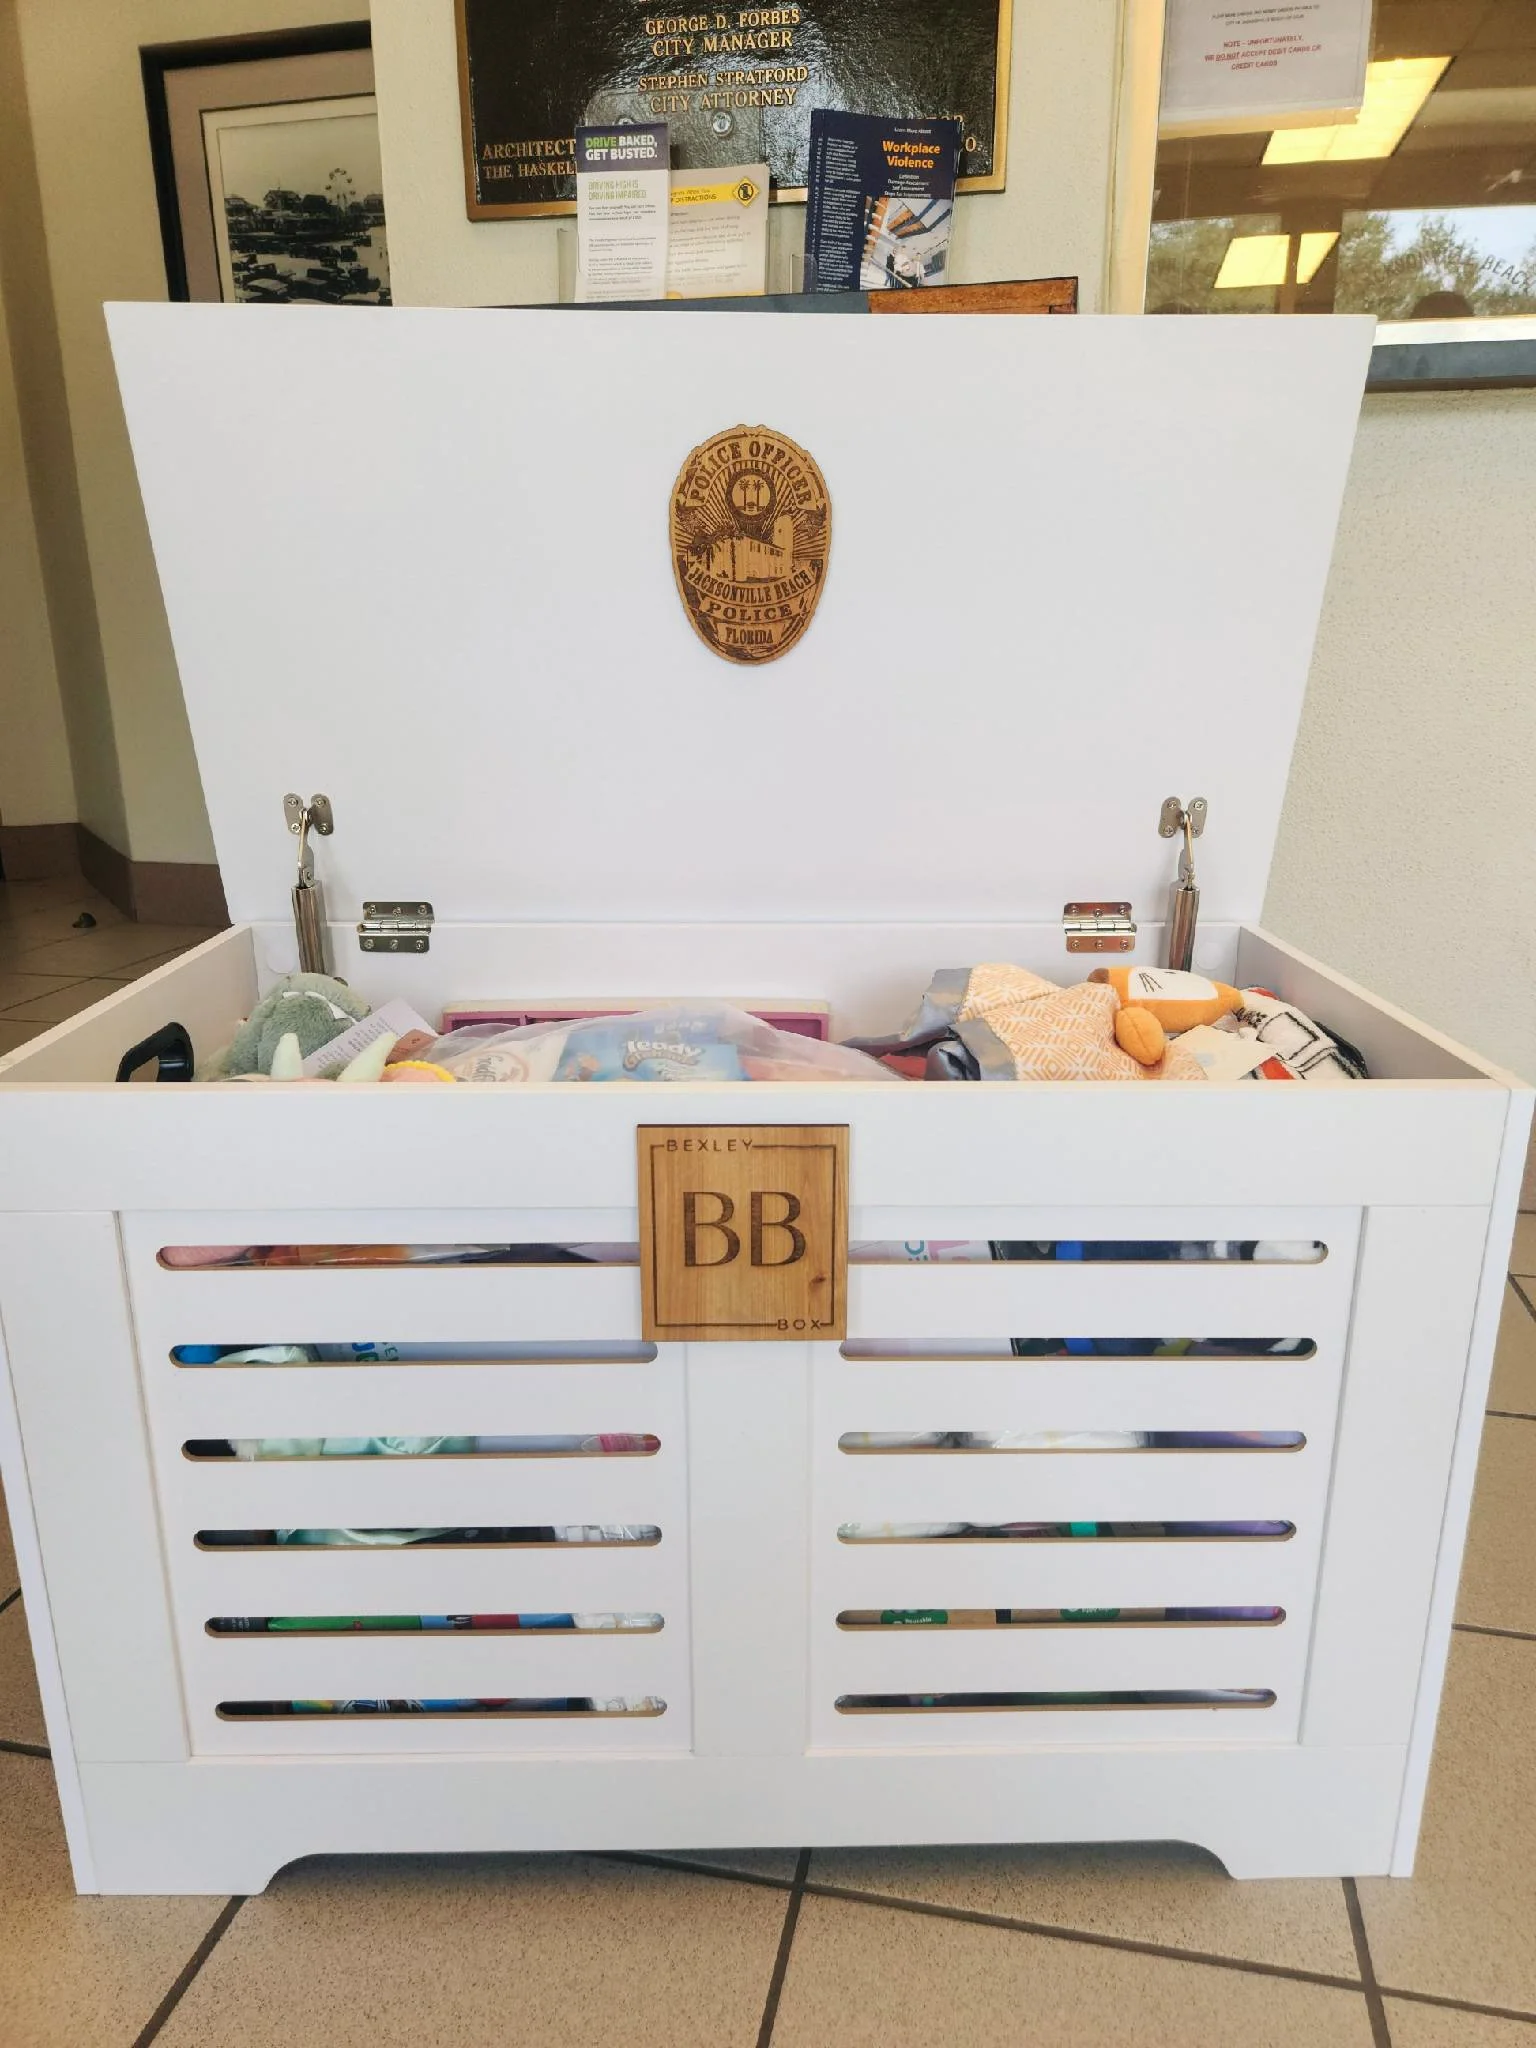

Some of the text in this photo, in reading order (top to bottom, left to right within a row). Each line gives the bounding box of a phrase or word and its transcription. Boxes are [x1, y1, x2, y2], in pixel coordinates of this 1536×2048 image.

[645, 9, 801, 35] GEORGE D. FORBES
[652, 30, 793, 57] CITY MANAGER
[1227, 52, 1240, 60] NOT
[638, 66, 809, 93] STEPHEN STRATFORD
[650, 87, 798, 113] CITY ATTORNEY
[585, 135, 658, 149] DRIVE BAKED,
[882, 140, 941, 156] Workplace
[585, 147, 658, 161] GET BUSTED.
[887, 156, 934, 169] Violence
[483, 160, 577, 180] THE HASKEL
[589, 191, 615, 200] DRIVING
[689, 440, 813, 504] POLICE OFFICER
[687, 567, 812, 604] JACKSONVILLE BEACH
[708, 601, 793, 621] POLICE
[725, 627, 774, 645] FLORIDA
[666, 1138, 754, 1152] BEXLEY
[682, 1190, 806, 1268] BB
[777, 1318, 822, 1331] BOX
